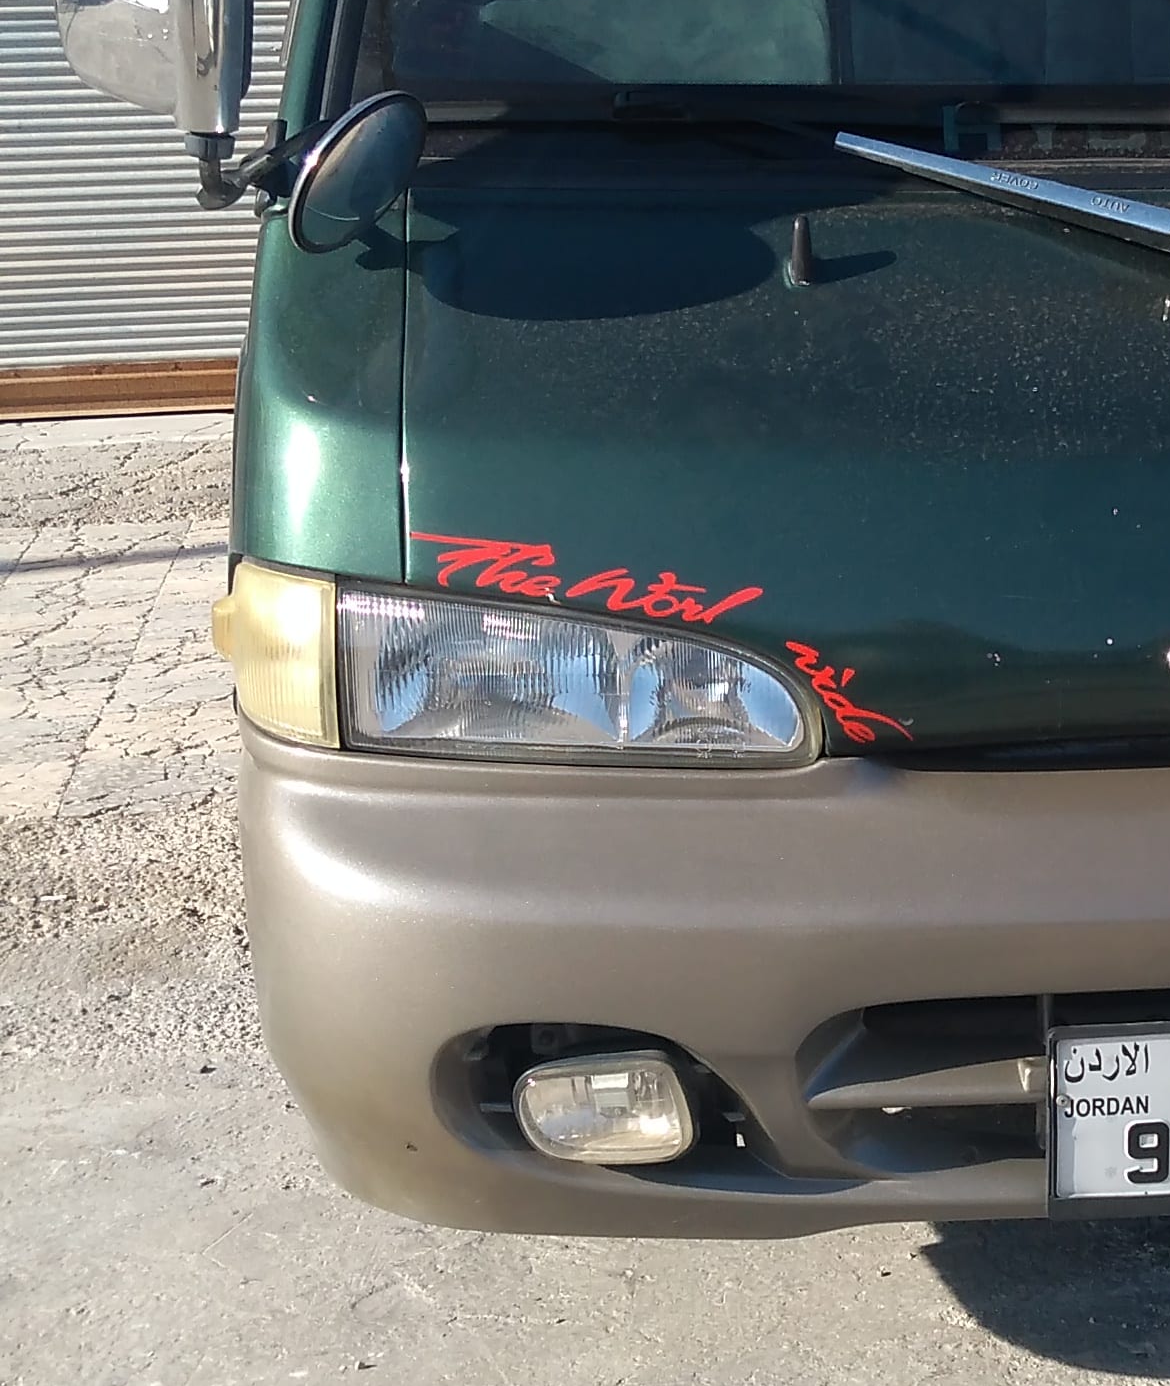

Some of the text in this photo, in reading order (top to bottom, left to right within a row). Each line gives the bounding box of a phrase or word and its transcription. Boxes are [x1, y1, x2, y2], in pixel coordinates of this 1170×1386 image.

[1090, 195, 1130, 214] AUTO
[410, 531, 562, 598] The
[1063, 1095, 1150, 1118] JORDAN
